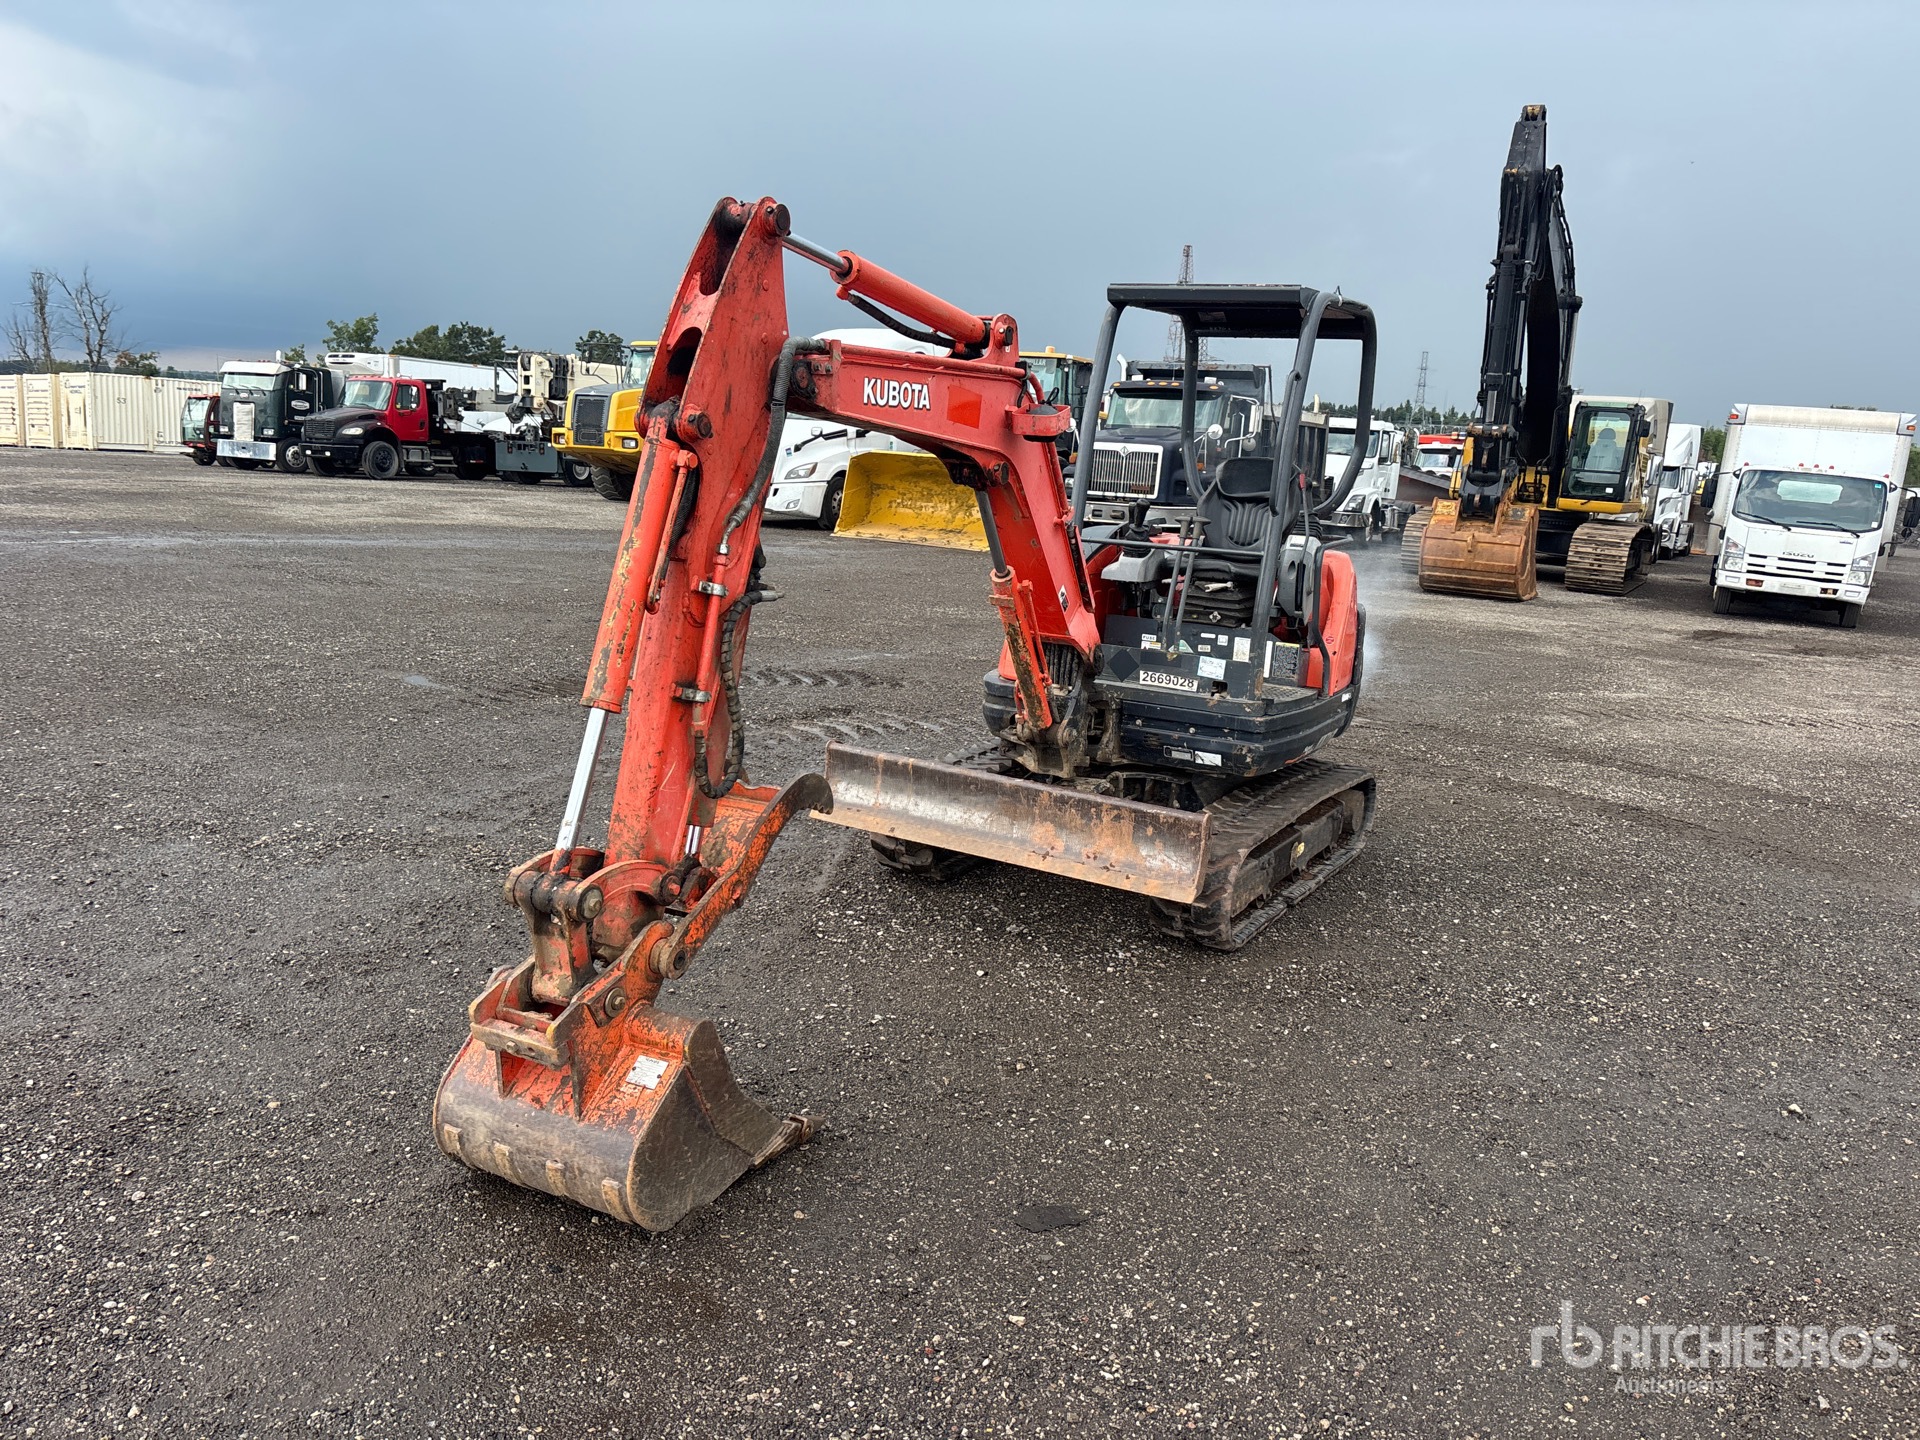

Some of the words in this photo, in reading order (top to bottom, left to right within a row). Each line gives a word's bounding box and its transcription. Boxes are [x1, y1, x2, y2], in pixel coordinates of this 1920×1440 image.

[863, 376, 931, 410] KUBOTA
[1782, 551, 1815, 559] ISUZU
[1141, 671, 1195, 689] 2669028
